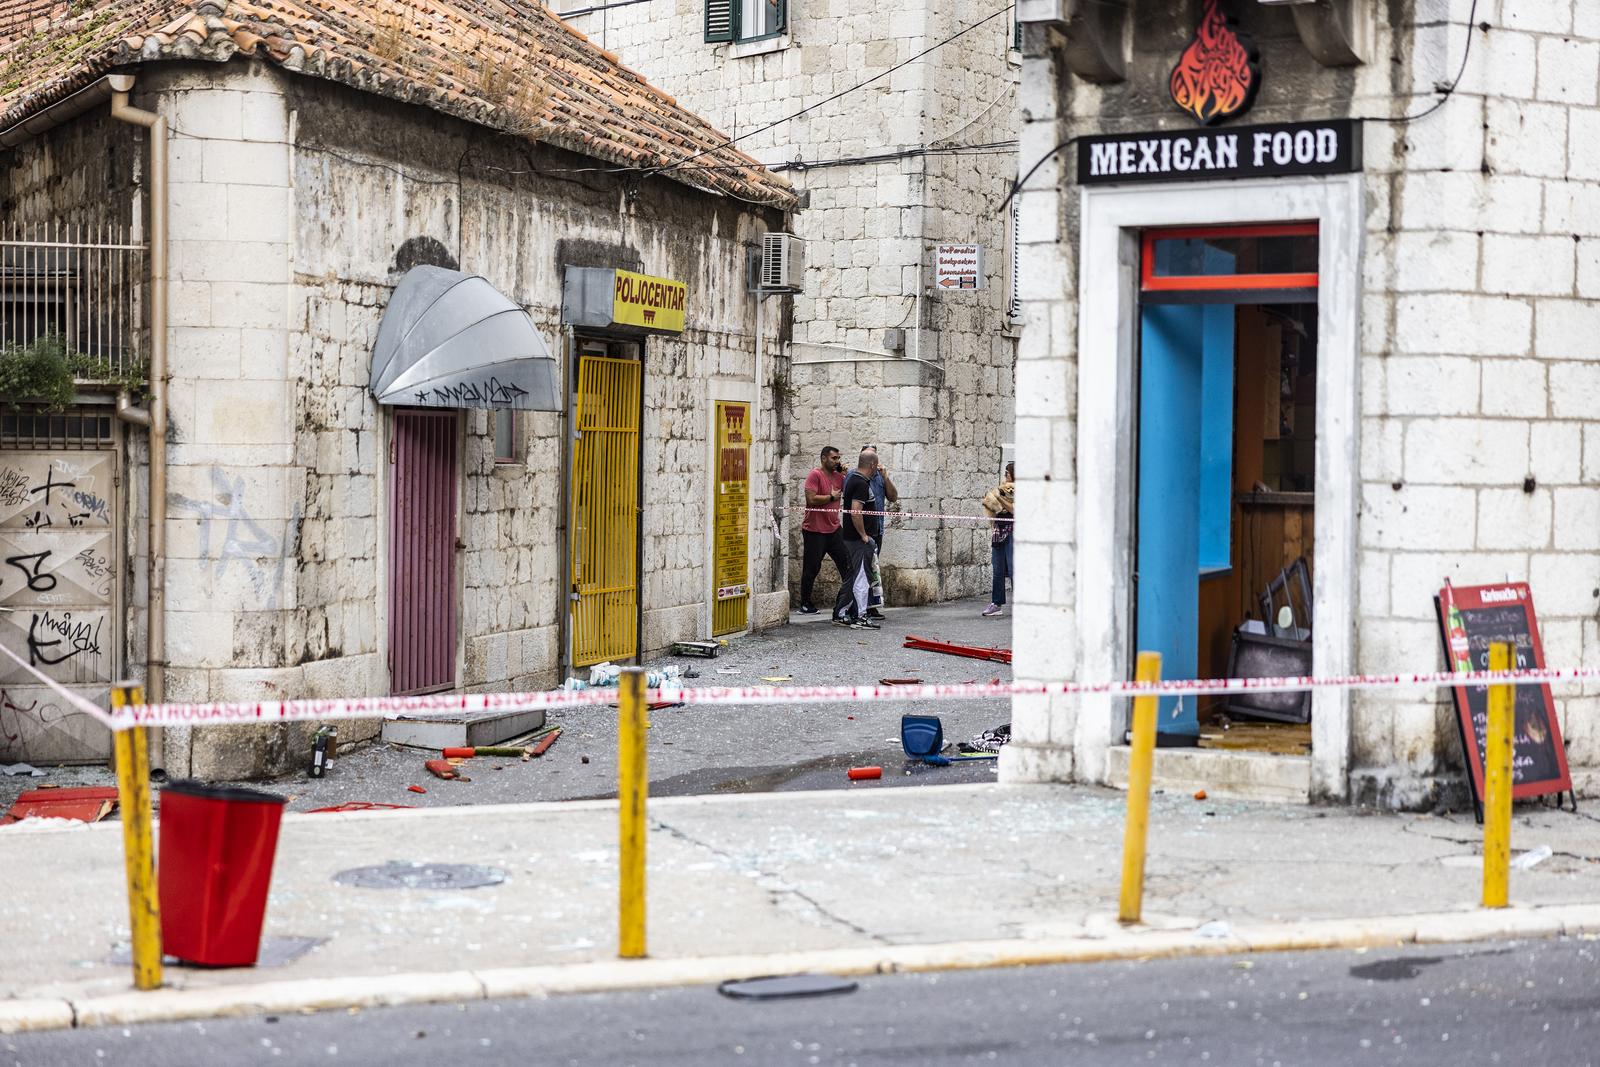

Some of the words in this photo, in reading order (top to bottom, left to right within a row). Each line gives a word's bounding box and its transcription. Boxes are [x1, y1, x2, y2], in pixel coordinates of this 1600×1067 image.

[1089, 134, 1238, 176] MEXICAN
[1252, 128, 1338, 167] FOOD
[615, 275, 685, 312] POLJOCENTAR
[289, 702, 337, 716] STOP
[492, 693, 535, 707] STOP
